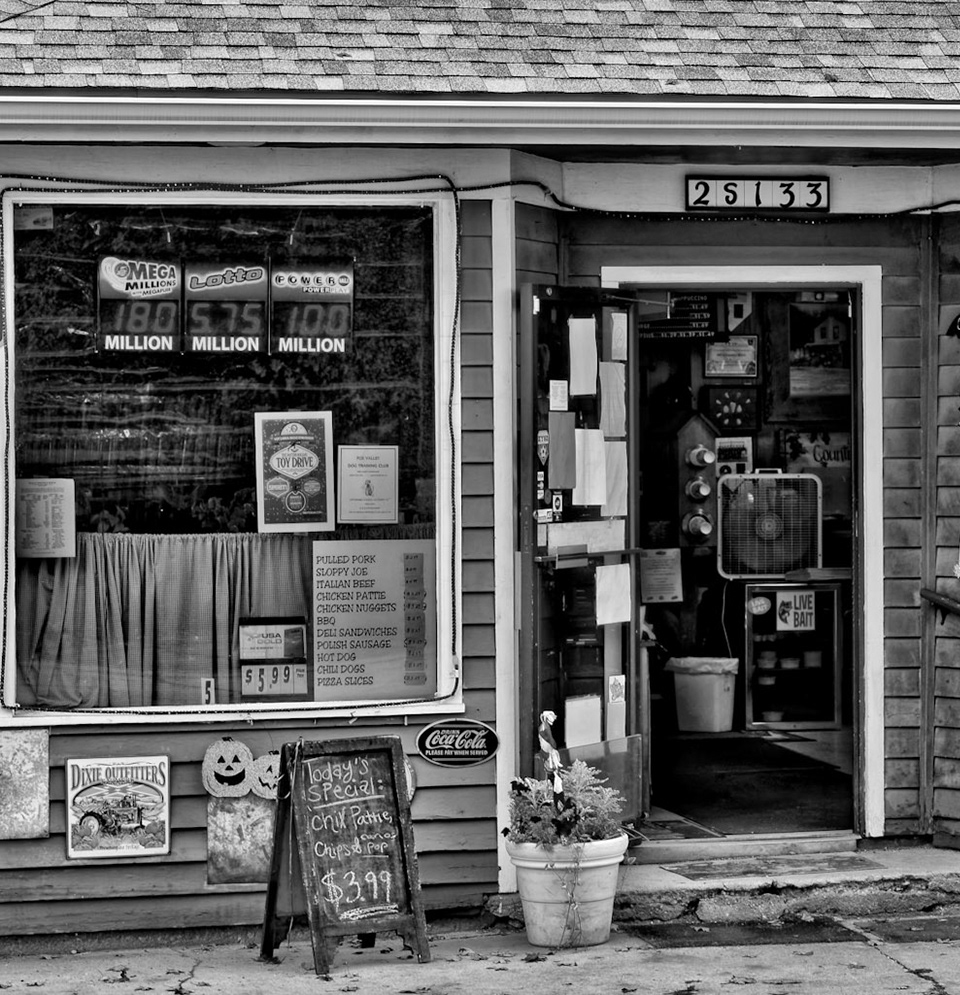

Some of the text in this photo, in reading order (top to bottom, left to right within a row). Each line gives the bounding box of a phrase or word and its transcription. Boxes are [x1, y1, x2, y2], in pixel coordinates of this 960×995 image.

[127, 262, 176, 280] MEGA
[190, 267, 263, 290] Lotto
[125, 280, 176, 291] MILLIONS
[114, 302, 177, 334] 180
[190, 303, 262, 334] 575
[287, 305, 349, 335] 100
[104, 335, 173, 351] MILLION
[192, 336, 260, 352] MILLION
[278, 338, 345, 353] MILLION
[276, 456, 313, 468] TOY DRIVE
[316, 555, 376, 564] PULLED PORK
[316, 567, 368, 576] SLOPPY JOE
[316, 580, 375, 588] ITALIAN BEEF
[316, 591, 386, 601] CHICKEN PATTIE
[794, 594, 813, 610] LIVE
[316, 603, 396, 613] CHICKEN NUGGETS
[317, 616, 336, 625] BBQ
[794, 611, 813, 628] BAIT
[317, 627, 397, 638] DELI SANDWICHES
[317, 640, 392, 649] POLISH SAUSAGE
[317, 652, 356, 662] HOT DOG
[317, 665, 365, 674] CHILI DOGS
[317, 676, 373, 686] PIZZA SLICES
[205, 680, 211, 704] 5
[425, 729, 489, 749] Coca-Cola
[105, 762, 165, 786] OUTFITTERS
[301, 756, 369, 784] Today's
[321, 868, 392, 912] $3.99
